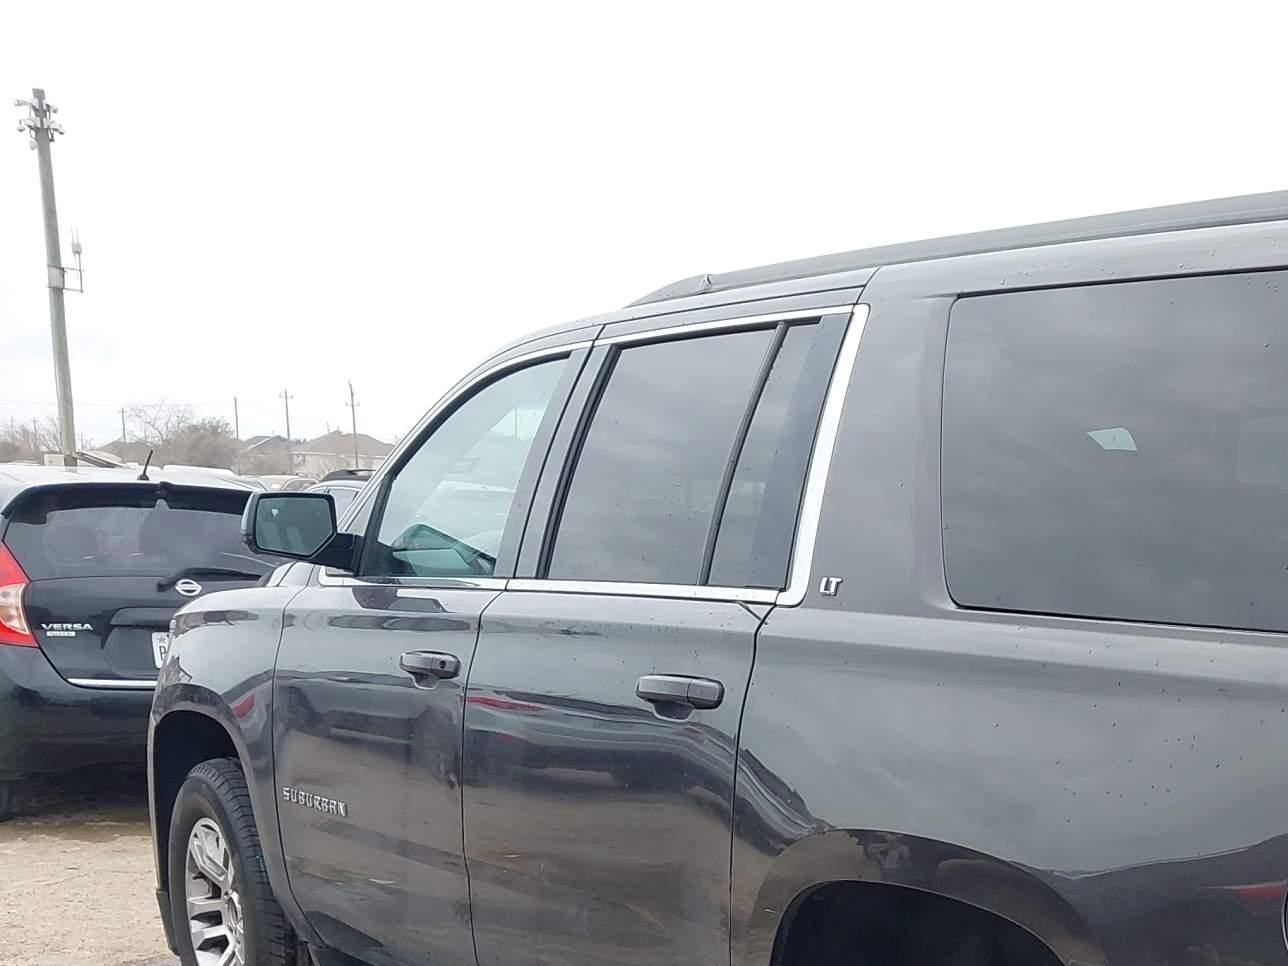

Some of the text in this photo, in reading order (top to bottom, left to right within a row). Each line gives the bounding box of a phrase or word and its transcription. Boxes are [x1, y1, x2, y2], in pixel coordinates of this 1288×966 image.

[819, 576, 843, 596] LT
[41, 623, 94, 631] VERSA
[282, 786, 348, 817] SUBURBAN
